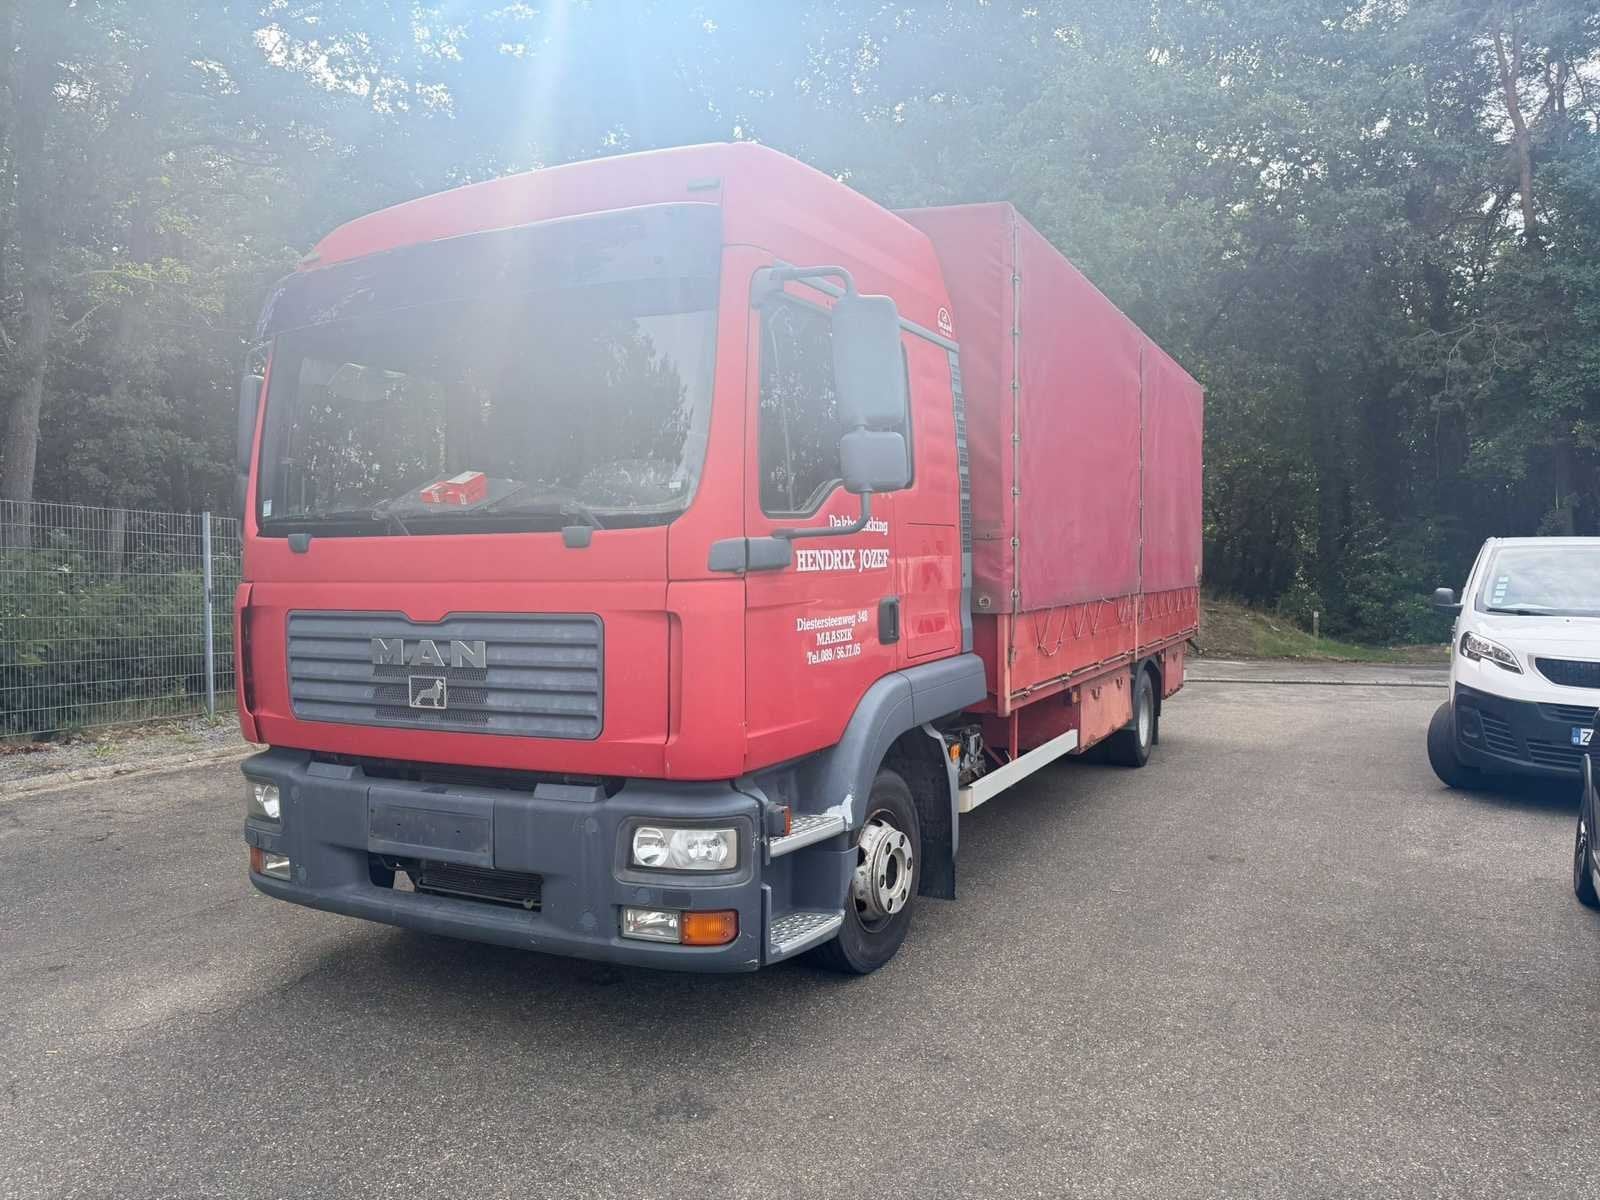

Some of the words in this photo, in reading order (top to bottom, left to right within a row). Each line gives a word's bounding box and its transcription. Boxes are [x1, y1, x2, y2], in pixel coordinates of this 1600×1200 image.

[796, 549, 856, 572] HENDRIX
[858, 549, 889, 573] JOZEF
[796, 614, 856, 632] Diestersteenweg
[816, 628, 853, 646] MAASEIK
[371, 637, 487, 669] MAN
